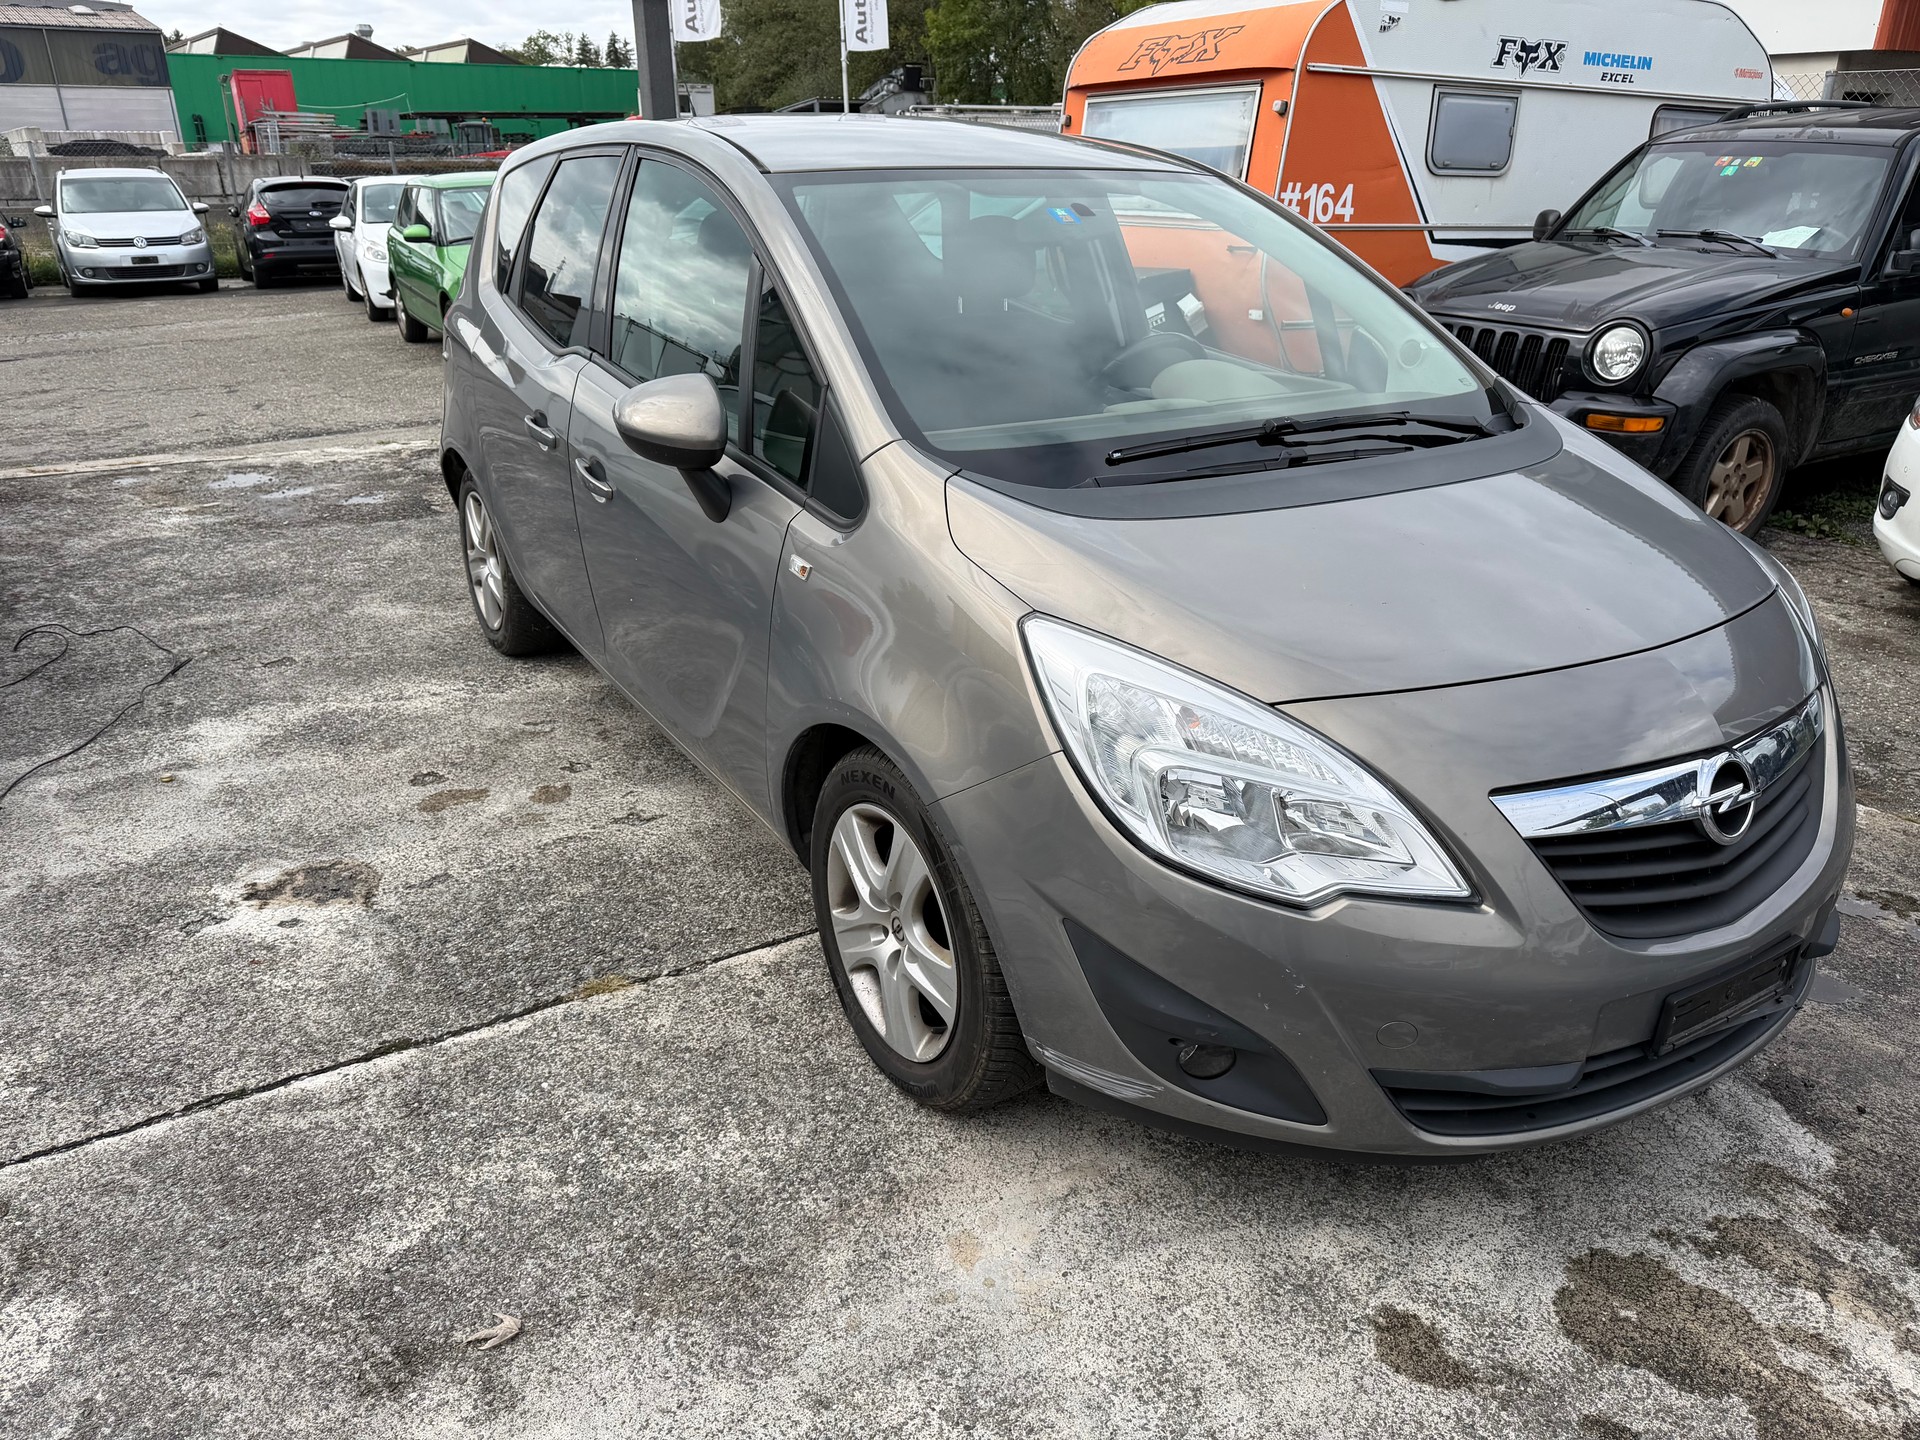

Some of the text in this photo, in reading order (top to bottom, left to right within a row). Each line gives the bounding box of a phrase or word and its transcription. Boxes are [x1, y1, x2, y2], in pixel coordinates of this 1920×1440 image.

[1582, 51, 1653, 71] MICHELIN
[1600, 71, 1635, 84] EXCEL
[1280, 182, 1355, 223] #164
[1487, 301, 1517, 313] Jeep
[1854, 350, 1899, 365] CHEROKEE
[841, 769, 895, 800] NEXEN
